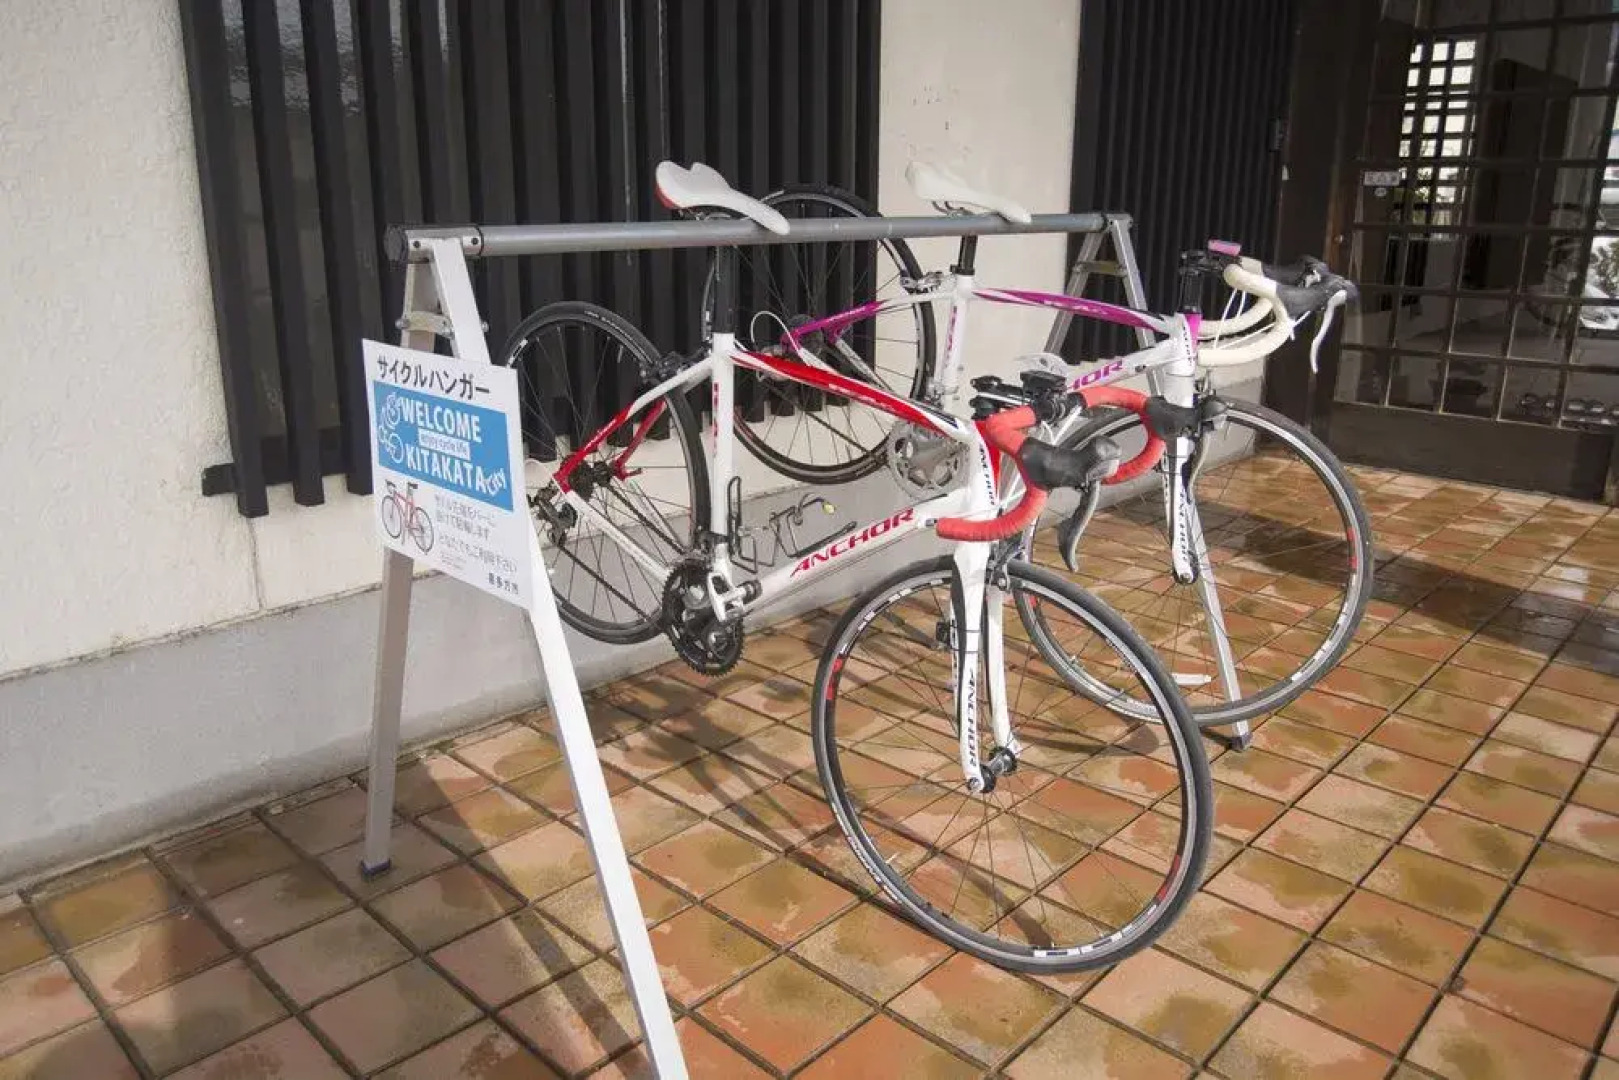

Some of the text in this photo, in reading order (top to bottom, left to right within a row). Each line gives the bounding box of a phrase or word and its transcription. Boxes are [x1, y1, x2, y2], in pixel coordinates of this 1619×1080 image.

[377, 354, 491, 400] サイクルハンガー
[400, 398, 482, 443] WELCOME
[405, 443, 487, 495] KITAKATA
[789, 505, 914, 578] ANCHOR
[966, 668, 978, 768] ANCHOR
